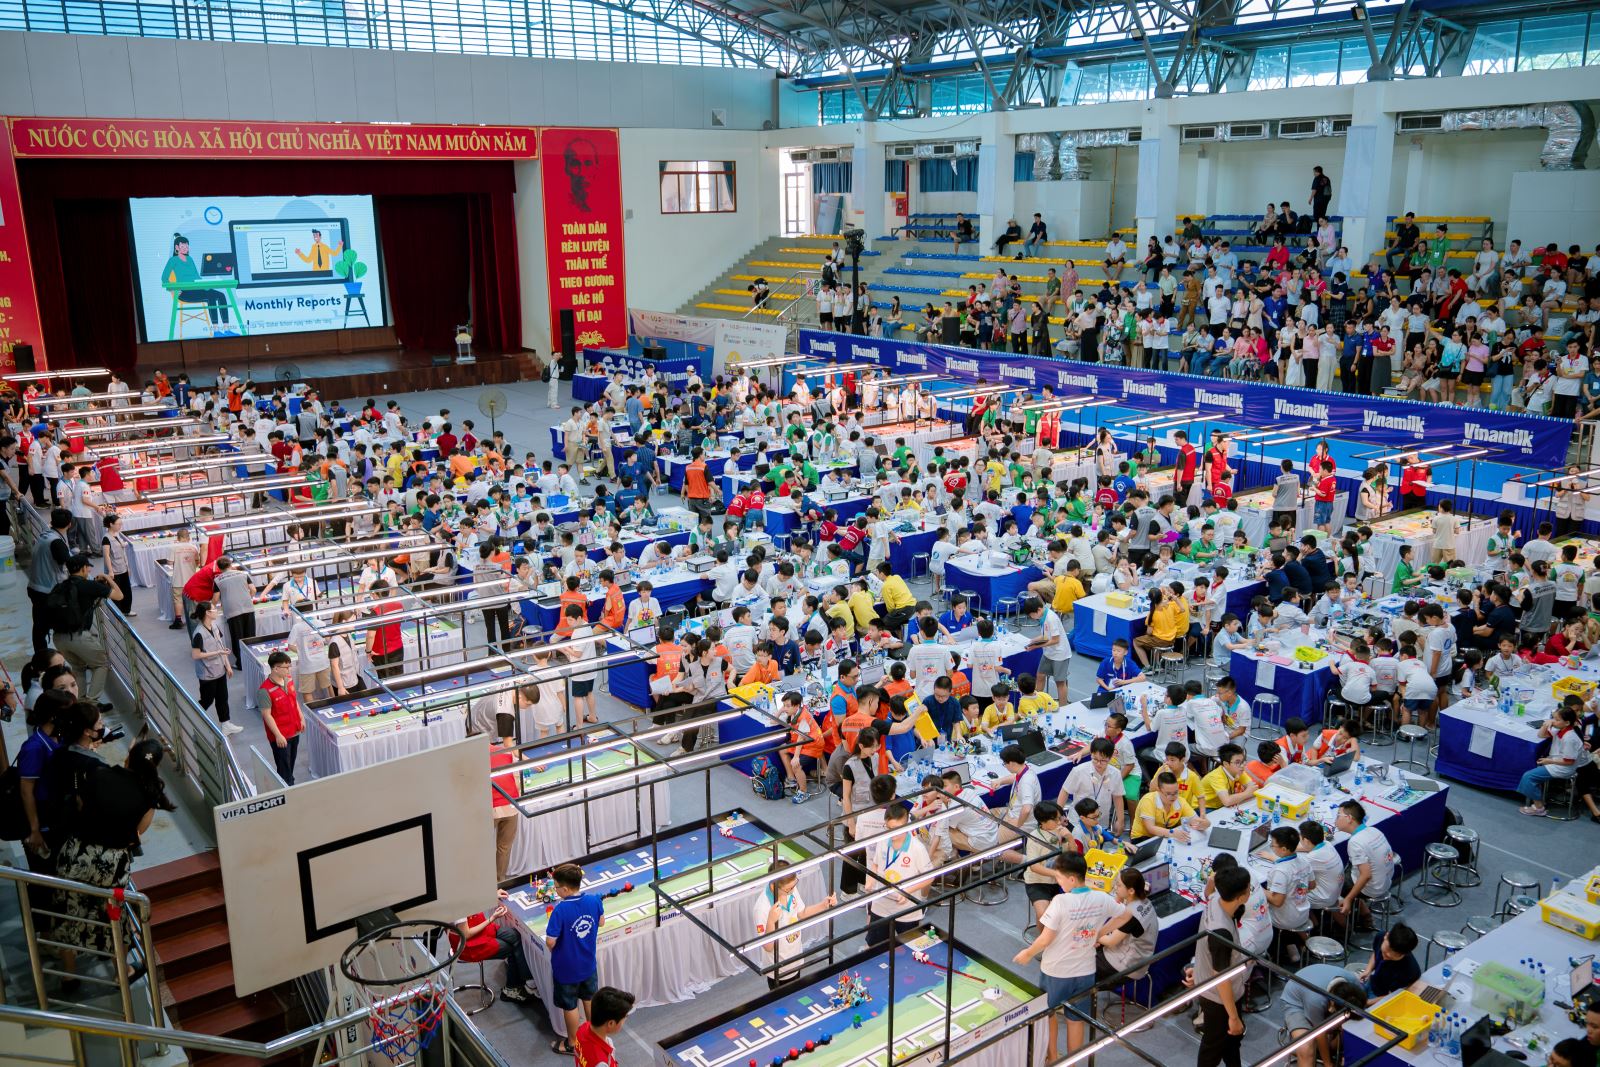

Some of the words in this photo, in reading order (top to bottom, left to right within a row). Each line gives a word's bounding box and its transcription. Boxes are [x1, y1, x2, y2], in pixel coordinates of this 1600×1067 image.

[28, 124, 88, 148] NƯỚC
[92, 125, 150, 153] CỘNG
[153, 125, 195, 149] HÒA
[198, 127, 226, 149] XÃ
[229, 127, 263, 154] HỘI
[267, 127, 302, 150] CHỦ
[307, 129, 361, 151] NGHĨA
[365, 129, 403, 155] VIỆT
[406, 134, 447, 151] NAM
[445, 130, 491, 152] MUÔN
[494, 131, 527, 152] NĂM
[562, 221, 586, 235] TOÀN
[588, 222, 607, 234] DÂN
[561, 239, 580, 253] RÈN
[582, 238, 610, 254] LUYỆN
[565, 257, 589, 271] THÂN
[591, 254, 608, 269] THỂ
[560, 277, 582, 288] THEO
[585, 275, 615, 287] GƯƠNG
[245, 298, 293, 311] Monthly
[297, 296, 341, 309] Reports
[572, 291, 590, 305] BÁC
[592, 289, 604, 304] HỒ
[576, 308, 586, 322] VĨ
[587, 309, 602, 323] ĐẠI
[945, 356, 979, 372] Vinamilk
[999, 363, 1036, 380] Vinamilk
[1057, 371, 1098, 389] Vinamilk
[1122, 378, 1167, 398] Vinamilk
[1194, 388, 1244, 408] Vinamilk
[1274, 398, 1329, 420] Vinamilk
[1363, 409, 1425, 433] Vinamilk
[1464, 422, 1534, 447] Vinamilk
[222, 808, 246, 819] VIFA
[249, 796, 284, 812] SPORT
[1004, 1005, 1029, 1024] Vinamilk
